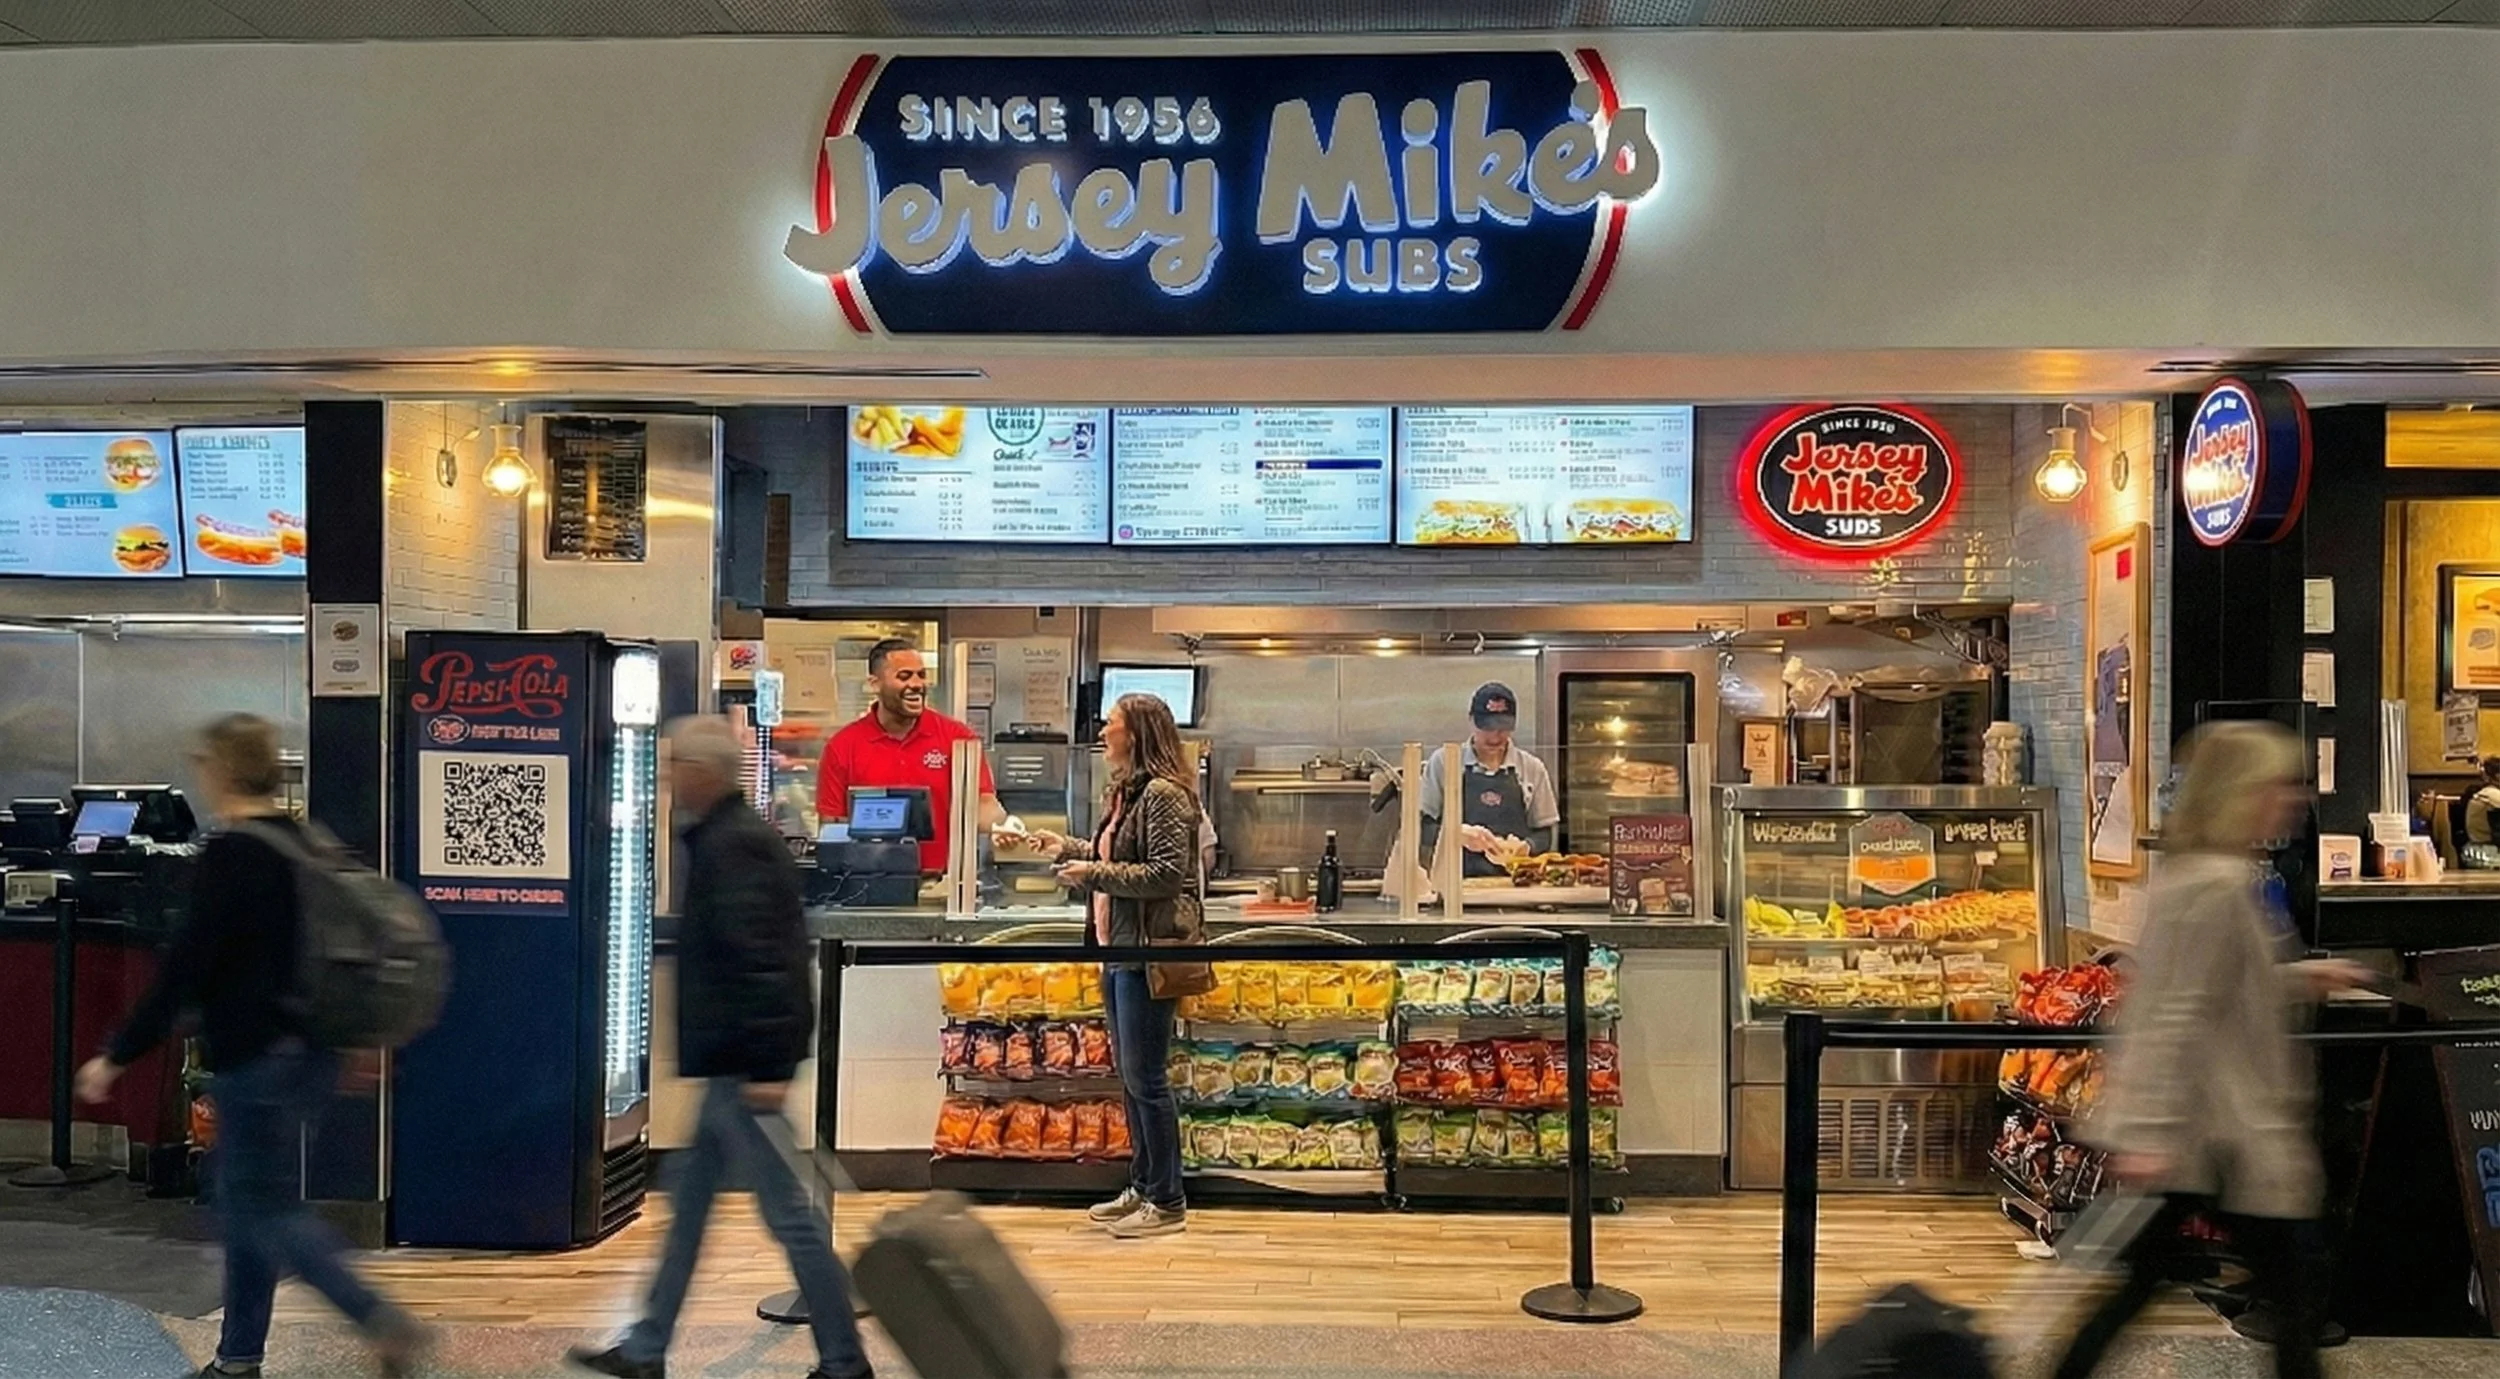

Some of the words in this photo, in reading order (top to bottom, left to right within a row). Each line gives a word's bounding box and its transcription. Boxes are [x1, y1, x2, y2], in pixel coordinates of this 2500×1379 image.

[898, 94, 1067, 142] SINCE
[1088, 96, 1221, 144] 1956
[783, 134, 1223, 296] Jersey
[1256, 80, 1661, 245] Mike's
[1303, 236, 1484, 295] SUBS
[1780, 431, 1928, 484] Jersey
